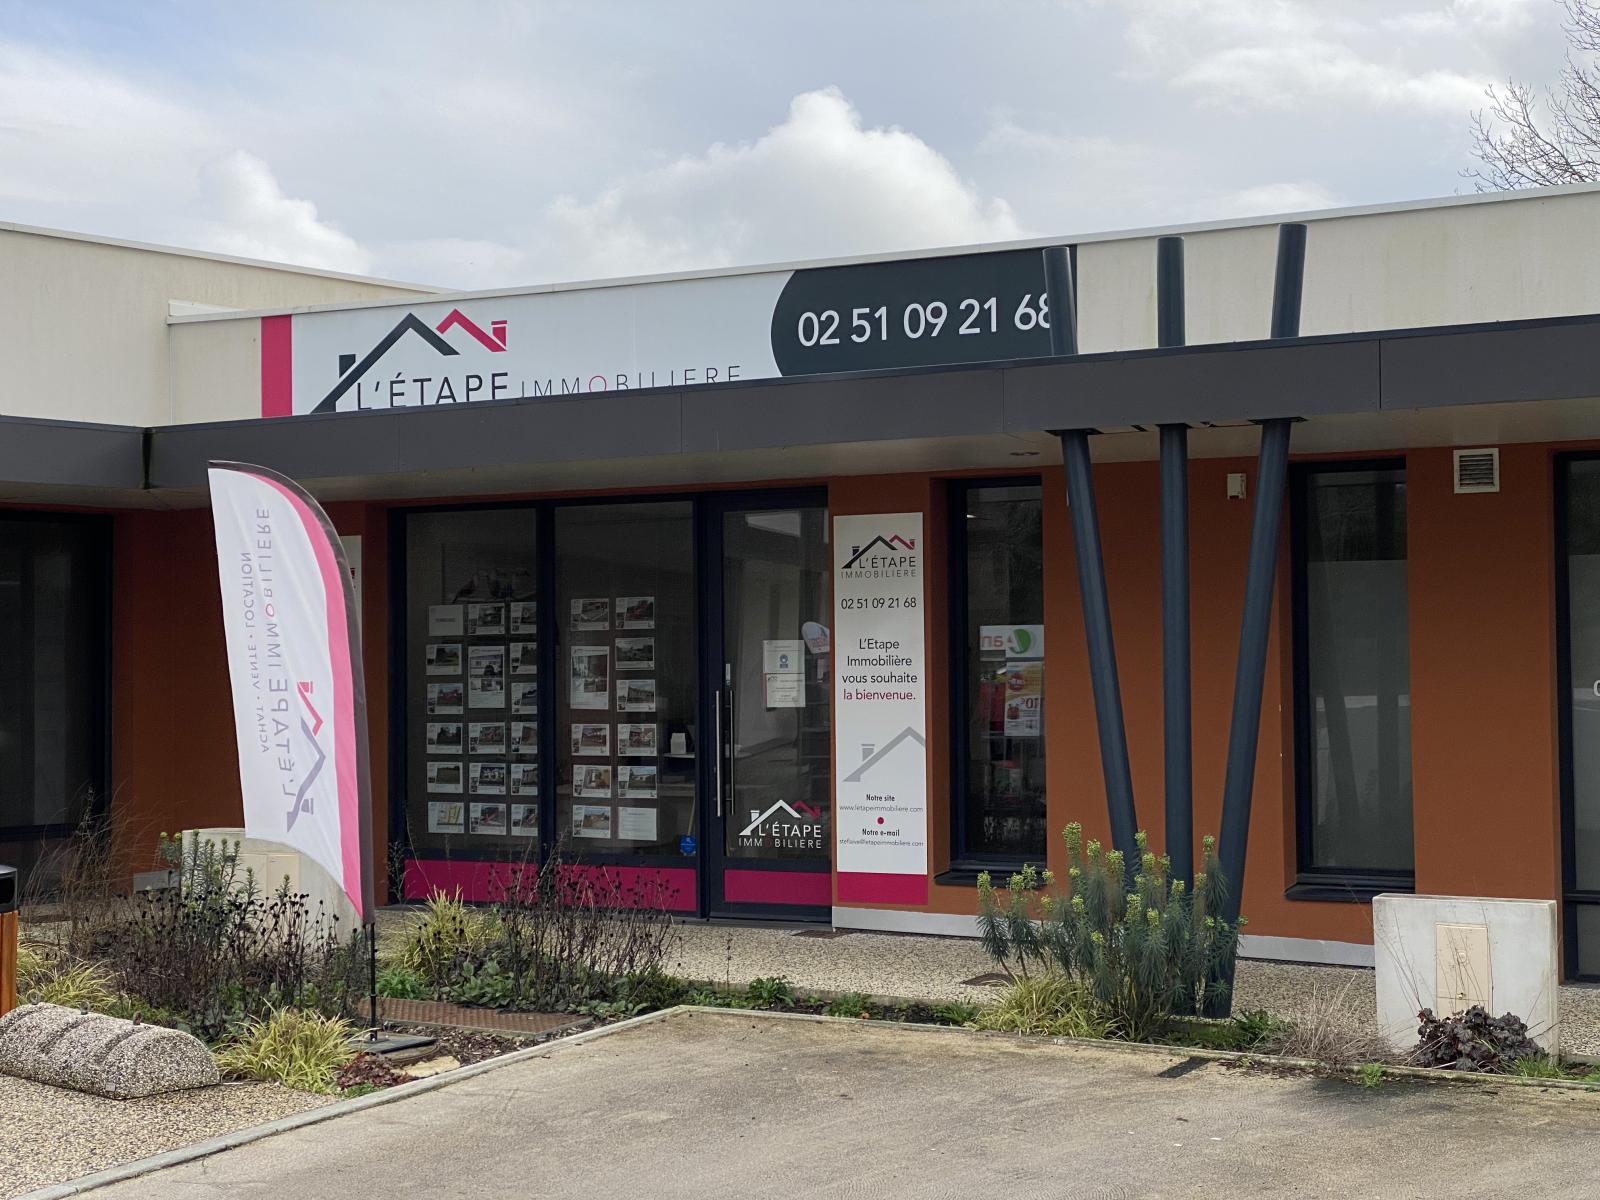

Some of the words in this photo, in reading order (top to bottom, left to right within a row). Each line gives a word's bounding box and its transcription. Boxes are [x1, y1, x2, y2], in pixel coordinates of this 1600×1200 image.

[798, 310, 840, 347] 02
[850, 306, 887, 343] 51
[903, 301, 948, 339] 09
[959, 297, 997, 335] 21
[859, 555, 917, 569] L'ÉTAPE
[841, 569, 917, 579] IMMOBILIERE
[841, 598, 854, 609] 02
[857, 598, 868, 609] 51
[872, 597, 885, 609] 09
[888, 597, 899, 608] 21
[903, 597, 917, 608] 68
[859, 638, 900, 653] L'Etape
[847, 655, 912, 666] Immobilière
[842, 675, 868, 684] vous
[870, 672, 918, 683] souhaite
[843, 689, 852, 700] la
[856, 689, 916, 700] bienvenue.
[759, 821, 822, 838] L'ÉTAPE
[862, 828, 878, 836] Notre
[880, 829, 900, 837] e-mail
